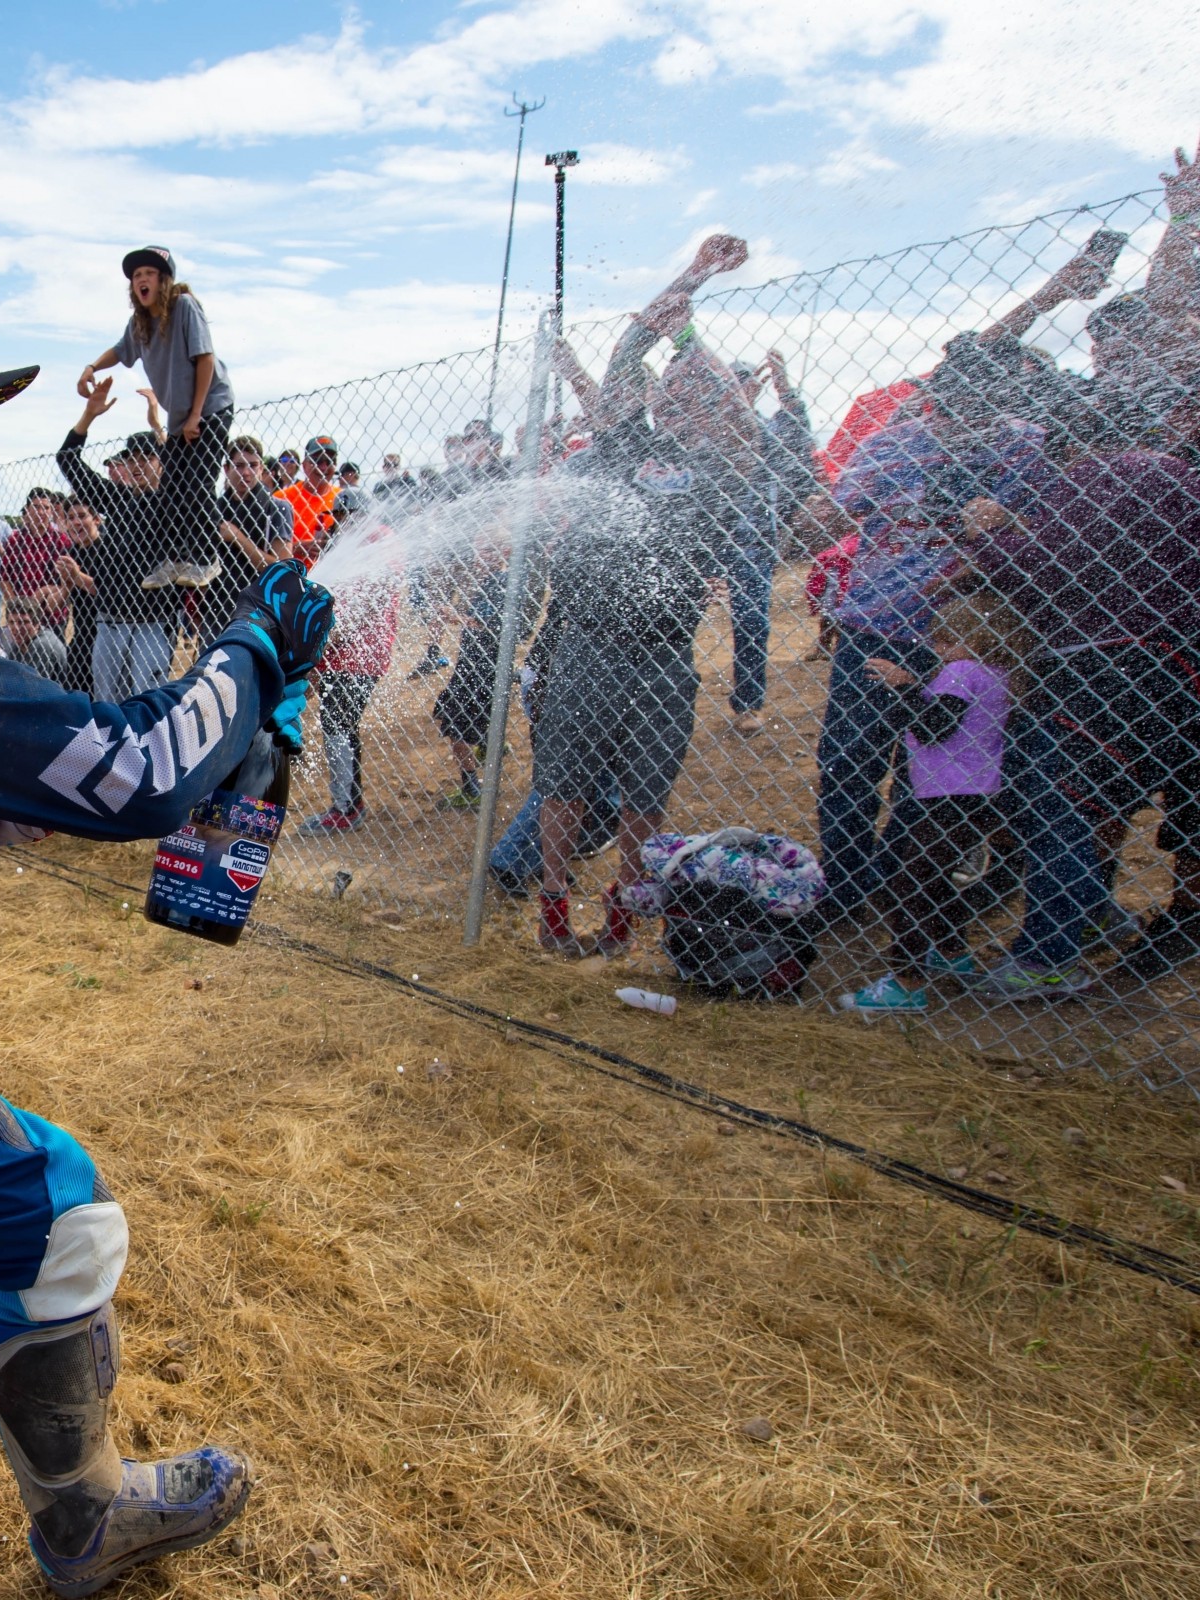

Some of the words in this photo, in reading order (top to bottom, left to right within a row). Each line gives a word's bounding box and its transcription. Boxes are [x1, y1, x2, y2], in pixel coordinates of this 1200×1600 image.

[238, 843, 267, 857] GoPro
[174, 860, 198, 874] 2016
[232, 859, 263, 874] HANGTOWN
